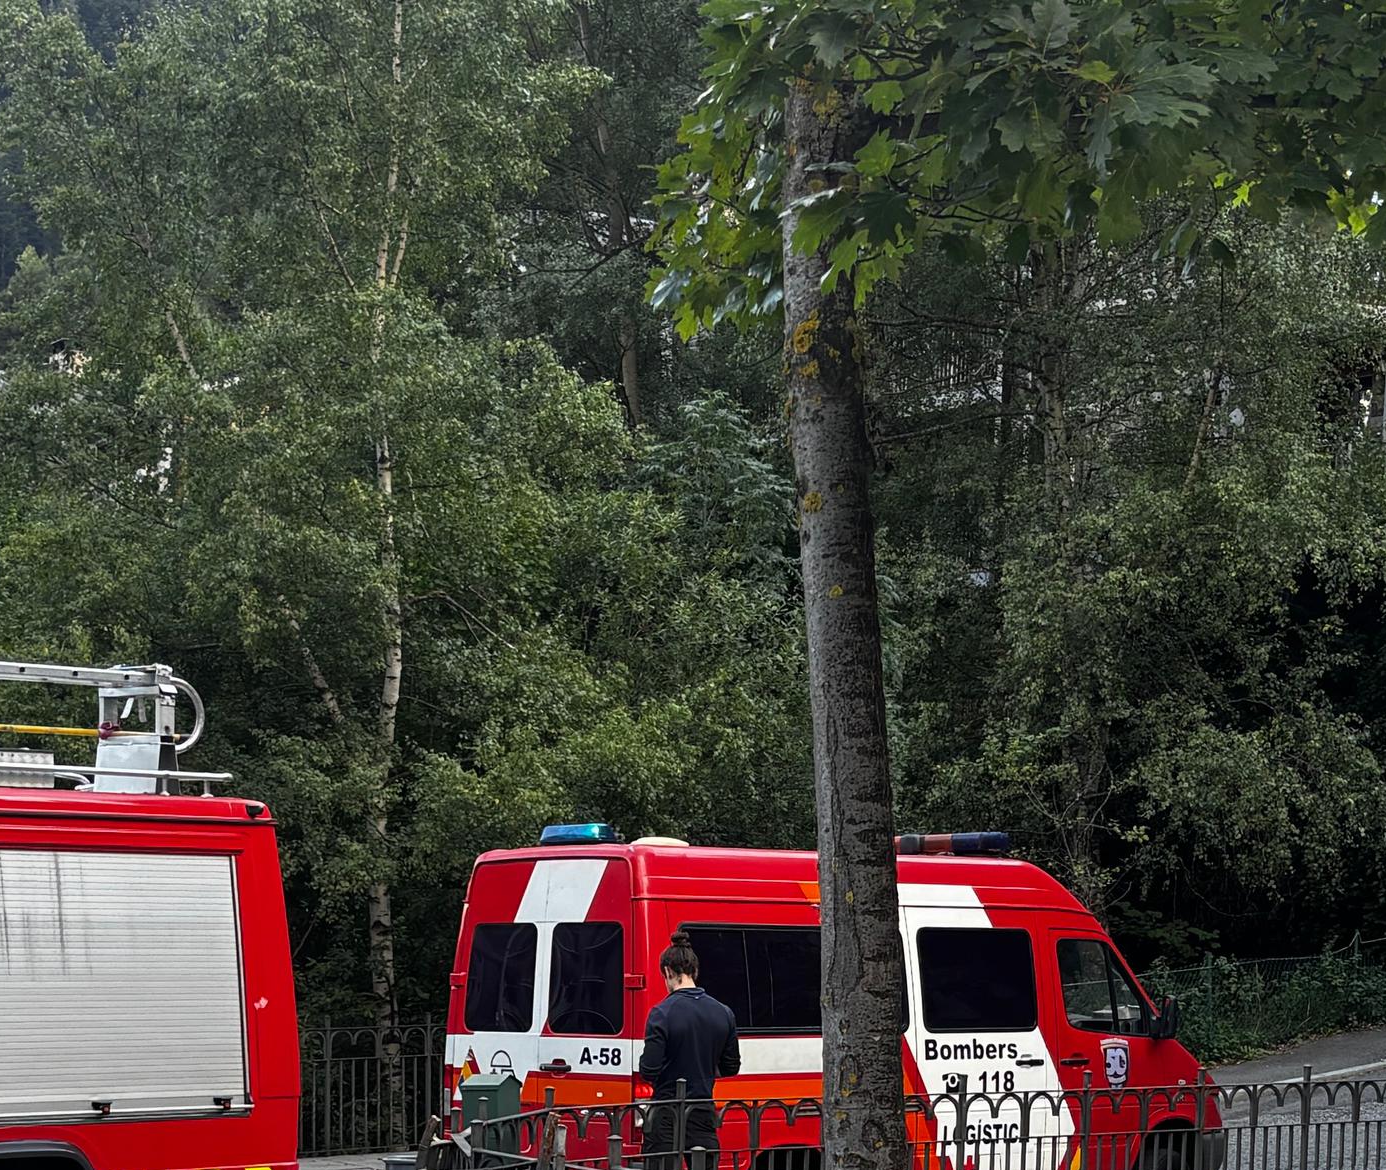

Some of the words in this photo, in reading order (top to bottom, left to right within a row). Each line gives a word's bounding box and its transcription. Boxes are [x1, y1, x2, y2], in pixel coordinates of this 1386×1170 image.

[579, 1047, 622, 1066] A-58
[925, 1038, 1018, 1060] Bombers
[979, 1071, 1014, 1092] 118
[944, 1119, 1029, 1145] LGÍSTIC
